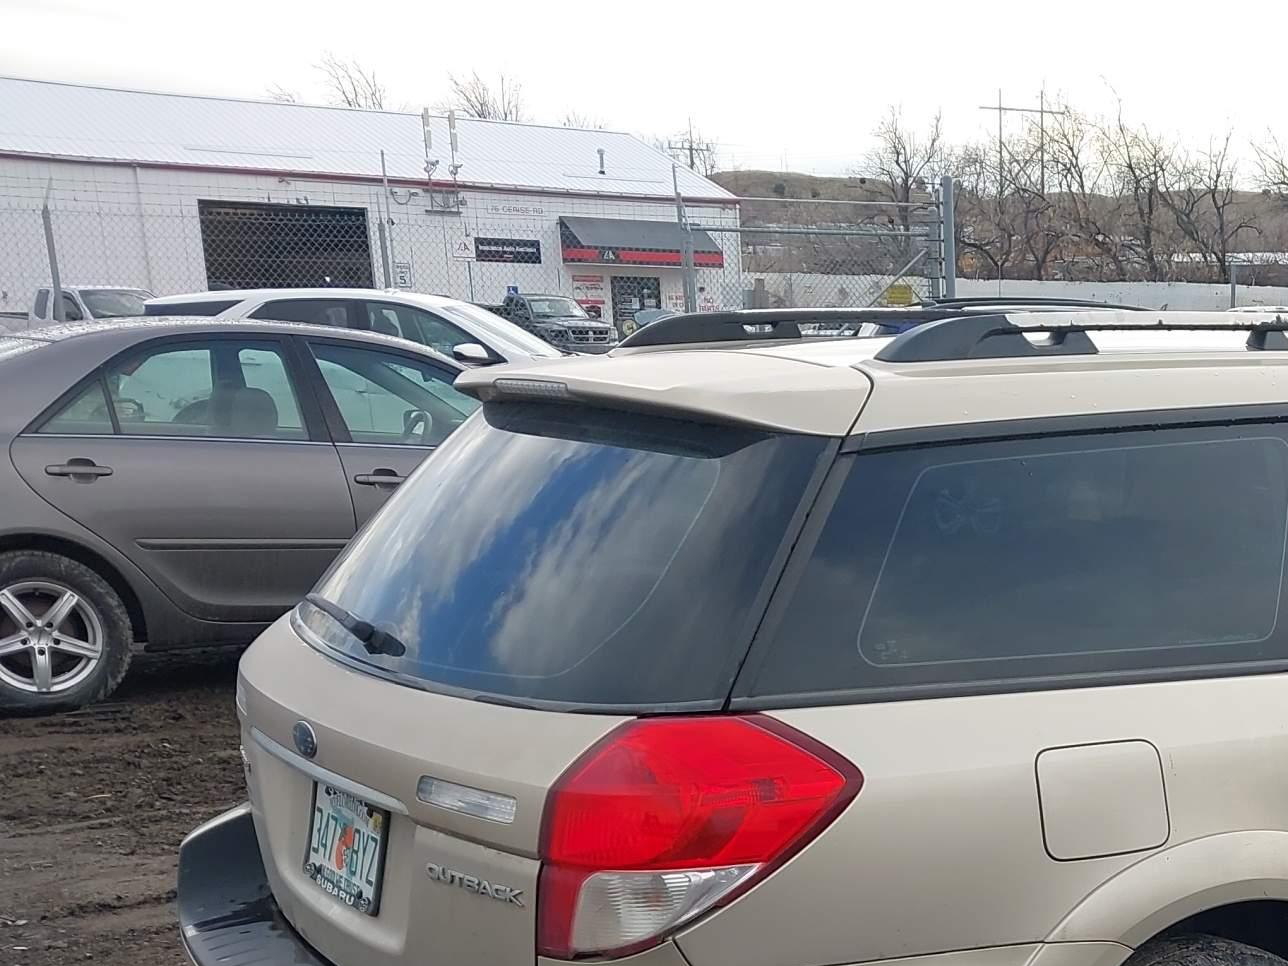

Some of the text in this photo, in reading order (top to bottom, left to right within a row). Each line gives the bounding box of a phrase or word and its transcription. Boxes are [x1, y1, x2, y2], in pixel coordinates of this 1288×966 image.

[399, 275, 407, 285] 5
[312, 806, 338, 862] 347
[315, 874, 355, 906] SUBARU
[425, 862, 525, 908] OUTBACK
